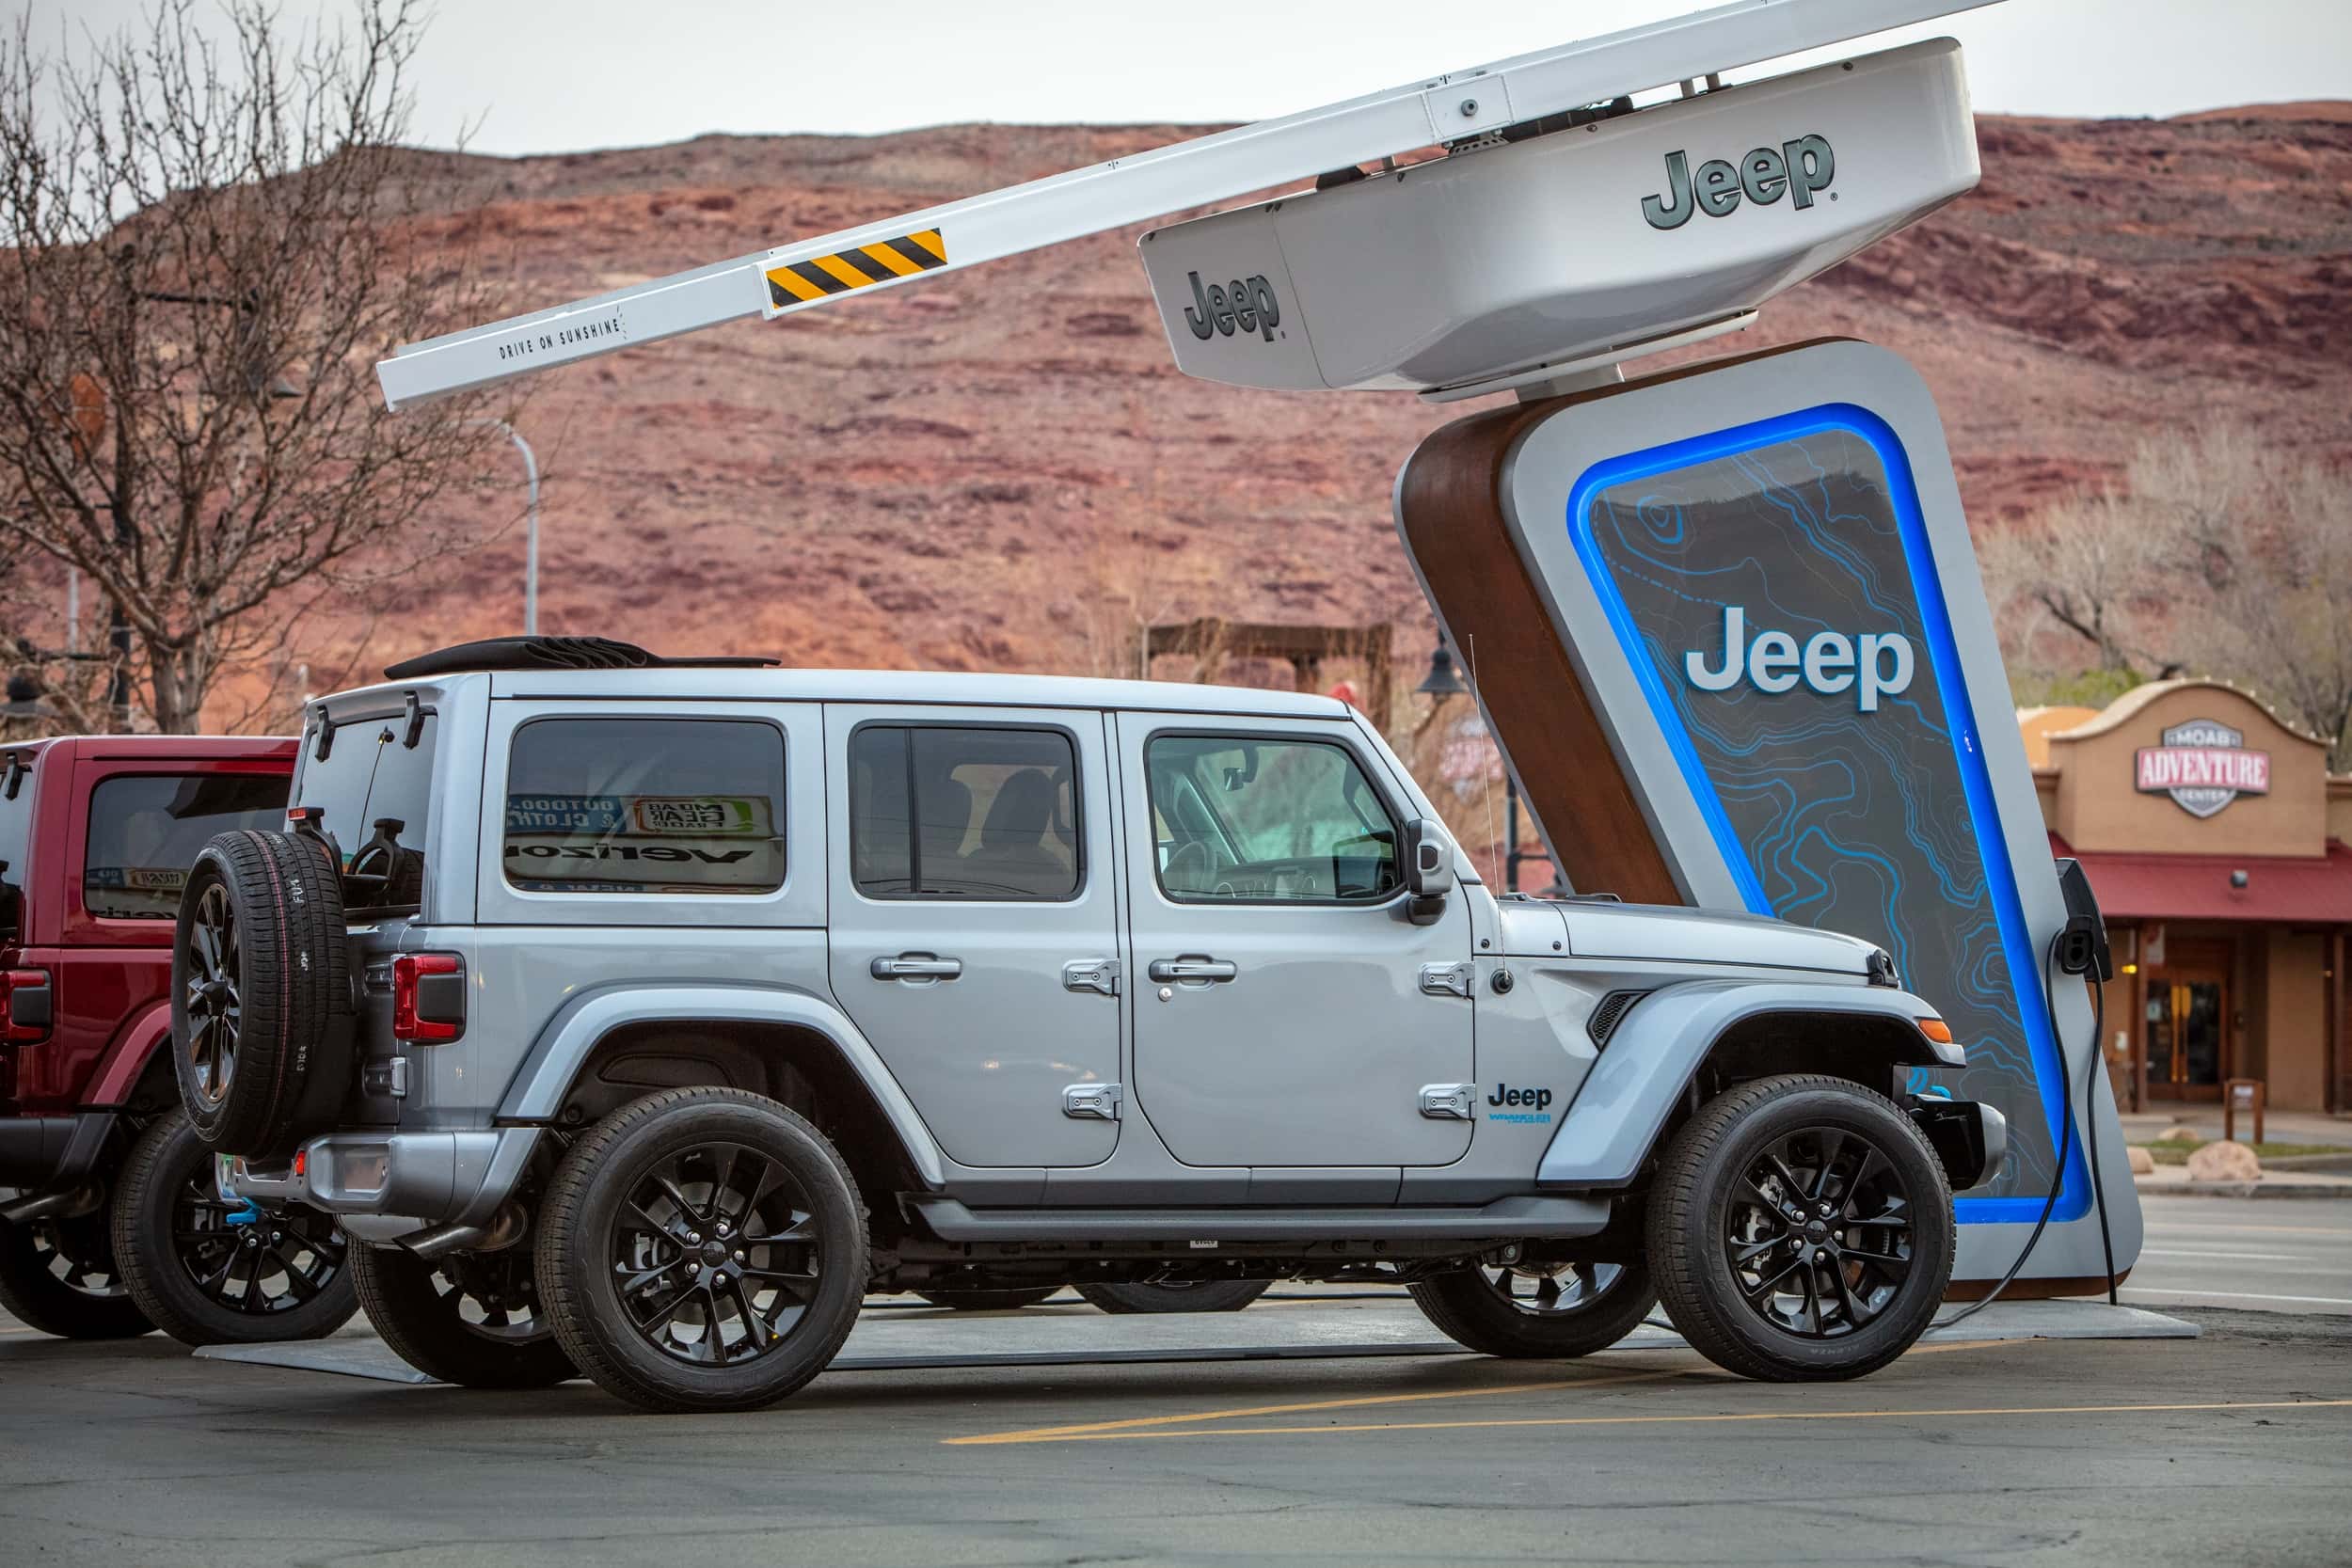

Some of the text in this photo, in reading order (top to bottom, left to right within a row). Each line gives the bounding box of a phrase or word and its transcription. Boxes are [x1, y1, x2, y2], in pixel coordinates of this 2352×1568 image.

[1641, 133, 1836, 230] Jeep
[1184, 270, 1280, 342] Jeep
[499, 318, 620, 359] DRIVE ON SUNSHINE
[1685, 606, 1915, 712] Jeep
[2176, 729, 2230, 747] MOAB
[2142, 750, 2267, 786] ADVENTURE
[1487, 1084, 1552, 1111] Jeep
